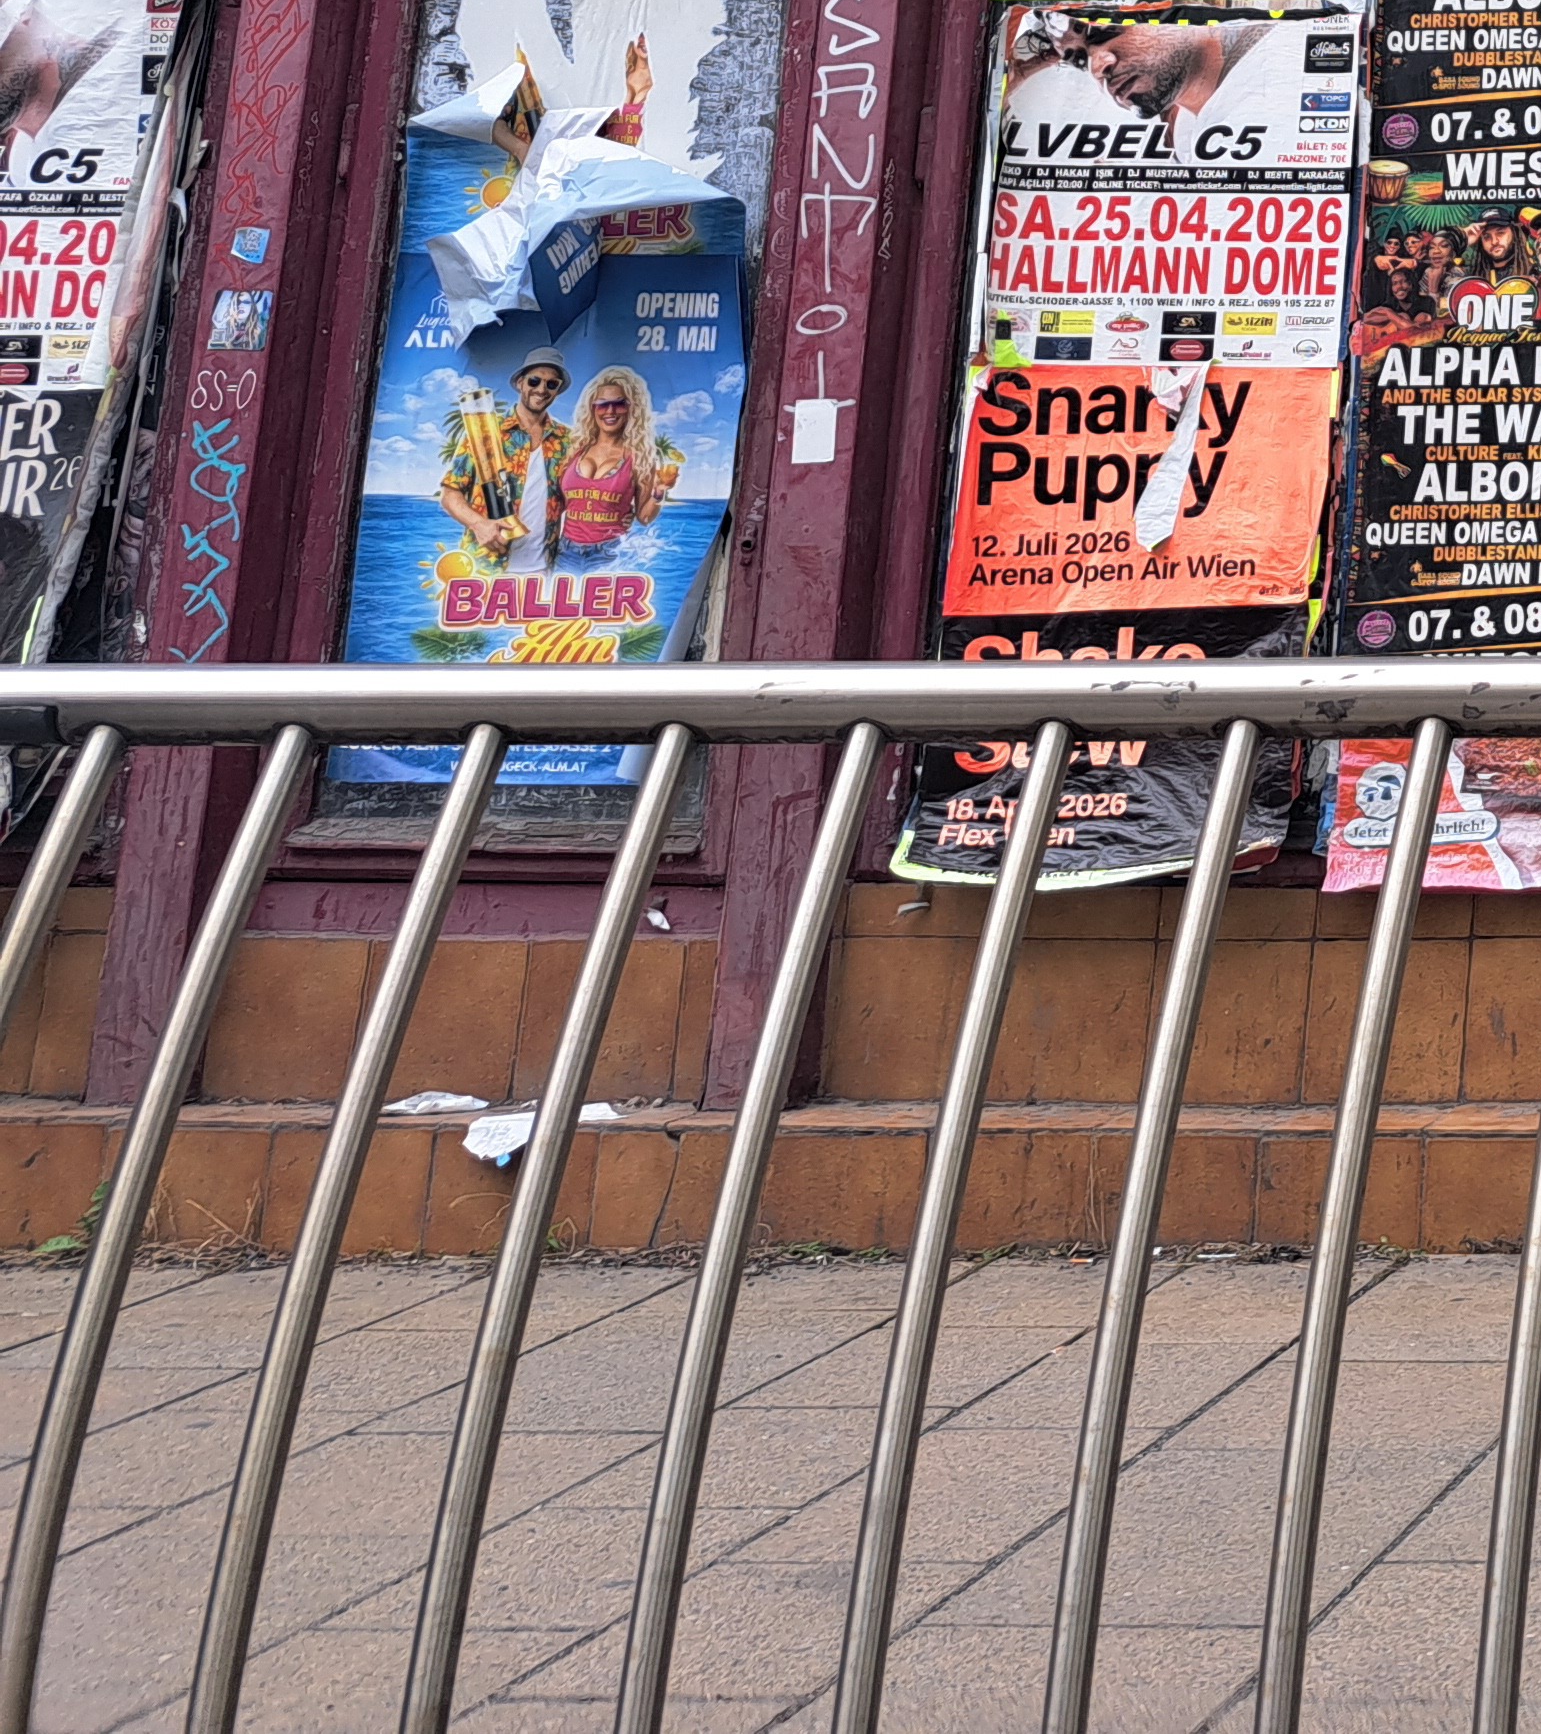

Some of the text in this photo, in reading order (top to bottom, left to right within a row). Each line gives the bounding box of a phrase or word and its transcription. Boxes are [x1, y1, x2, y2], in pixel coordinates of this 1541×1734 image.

[1410, 13, 1521, 28] CHRISTOPHER
[1387, 30, 1466, 54] QUEEN
[1008, 122, 1268, 161] LVBEL C5
[1431, 113, 1483, 143] 07.
[1493, 111, 1516, 137] &
[29, 147, 104, 185] C5
[993, 195, 1343, 243] SA.25.04.2026
[988, 245, 1337, 296] HALLMANN DOME
[635, 291, 720, 321] OPENING
[636, 325, 719, 354] 28. MAI
[973, 531, 1130, 559] 12. Juli 2026
[968, 554, 1256, 587] Arena Open Air Wien
[440, 575, 653, 624] BALLER
[938, 824, 995, 847] Flex
